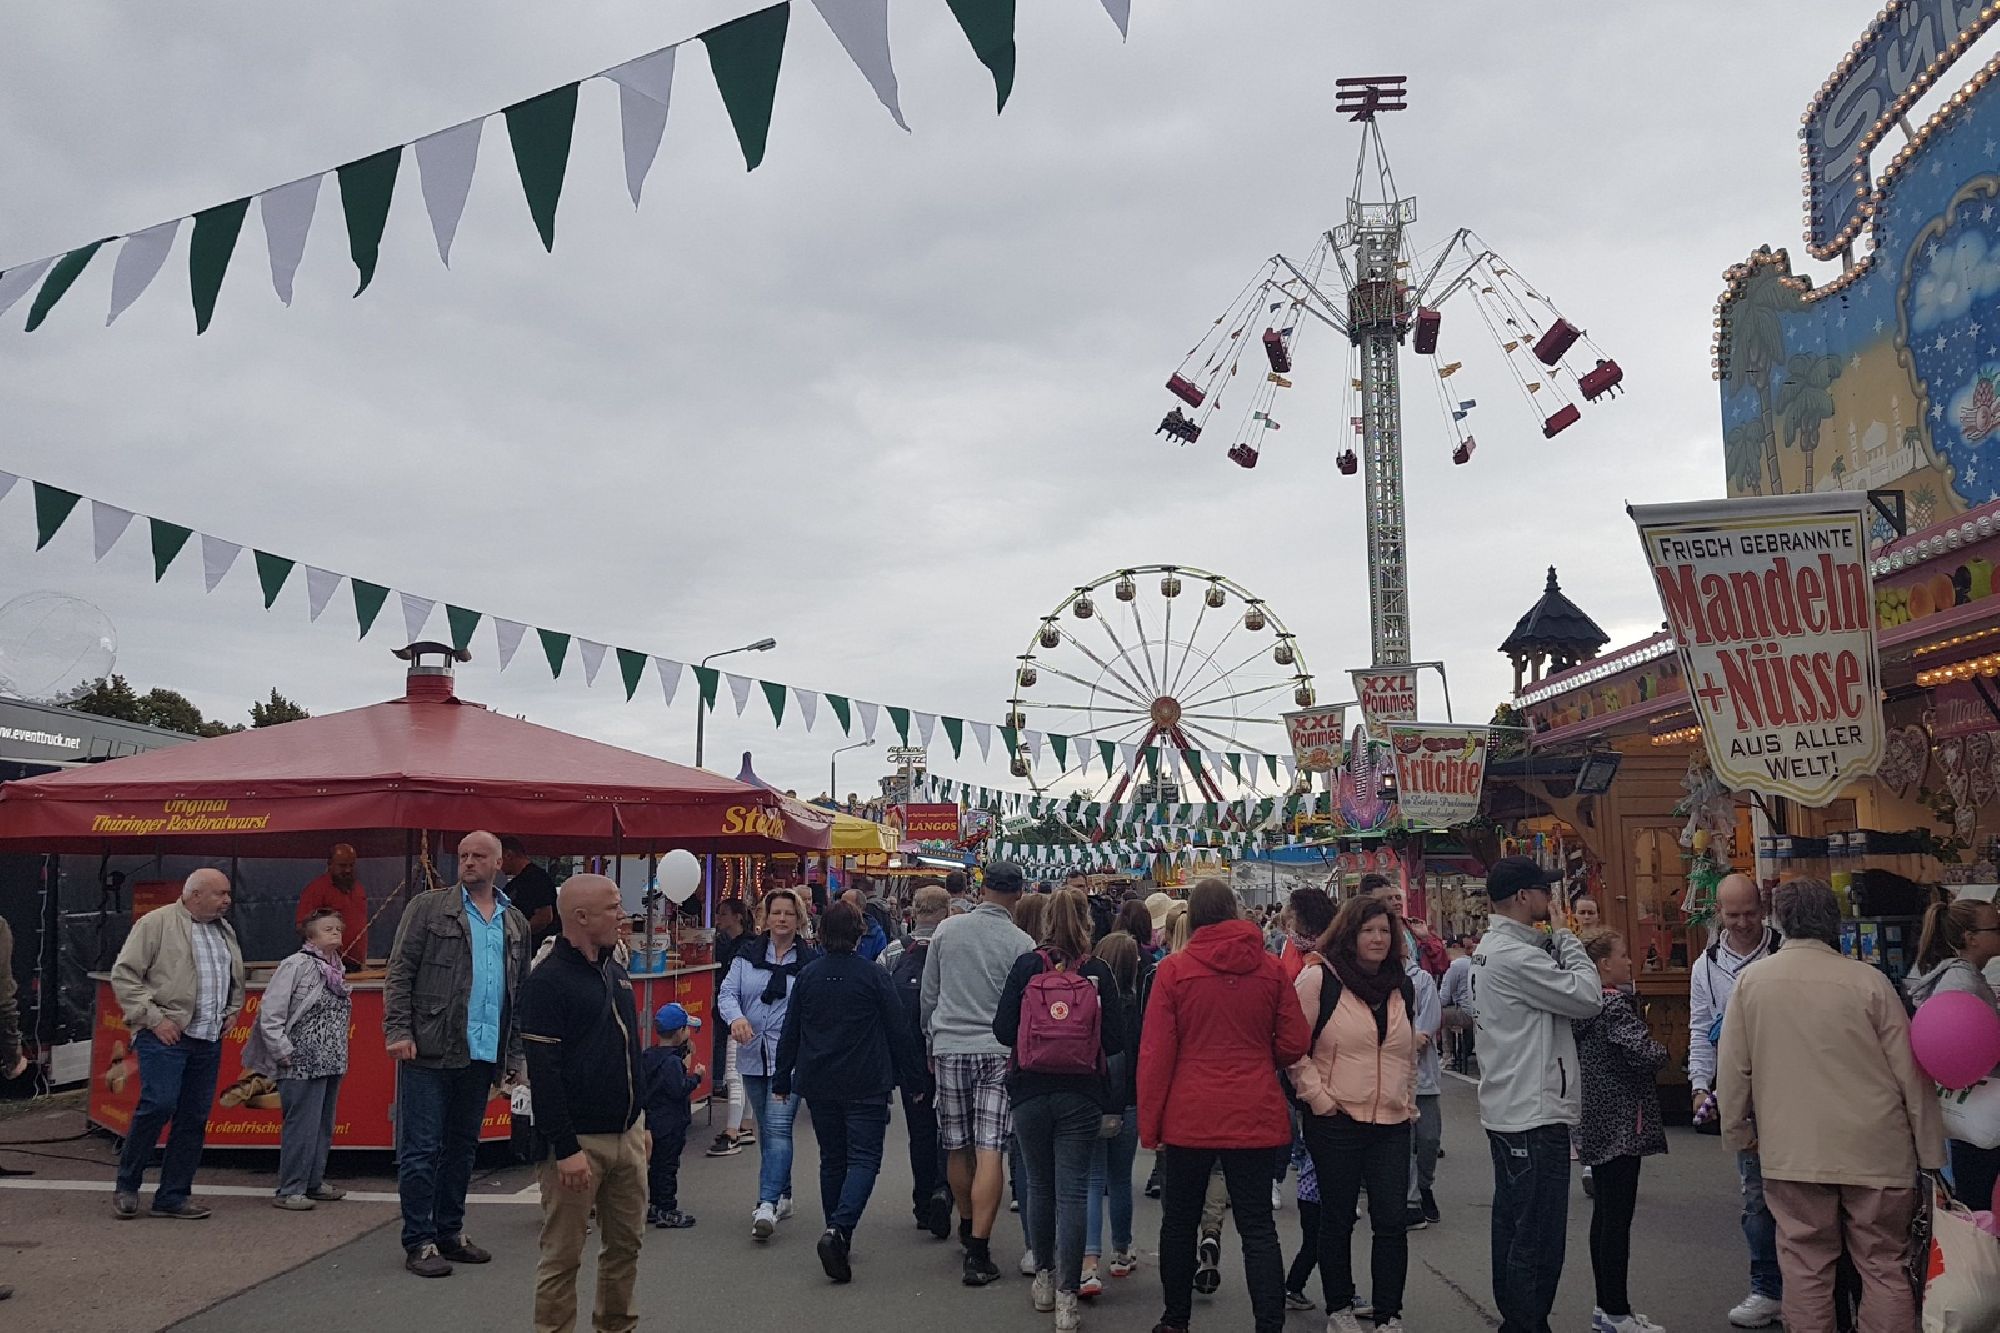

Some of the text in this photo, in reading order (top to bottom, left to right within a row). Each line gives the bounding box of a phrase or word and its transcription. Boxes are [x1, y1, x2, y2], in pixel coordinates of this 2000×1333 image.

[1658, 528, 1853, 561] FRISCH GEBRANNTE
[1655, 553, 1870, 645] Mandeln
[1362, 675, 1413, 693] XXL
[1362, 690, 1414, 713] Pommes
[1294, 713, 1341, 730] XXL
[1292, 728, 1341, 748] Pommes
[1730, 725, 1863, 758] AUS ALLER
[1396, 753, 1480, 794] Früchte
[1764, 752, 1839, 780] WELT!
[164, 800, 229, 815] Original
[91, 813, 271, 835] Thüringer Rostbratwurst
